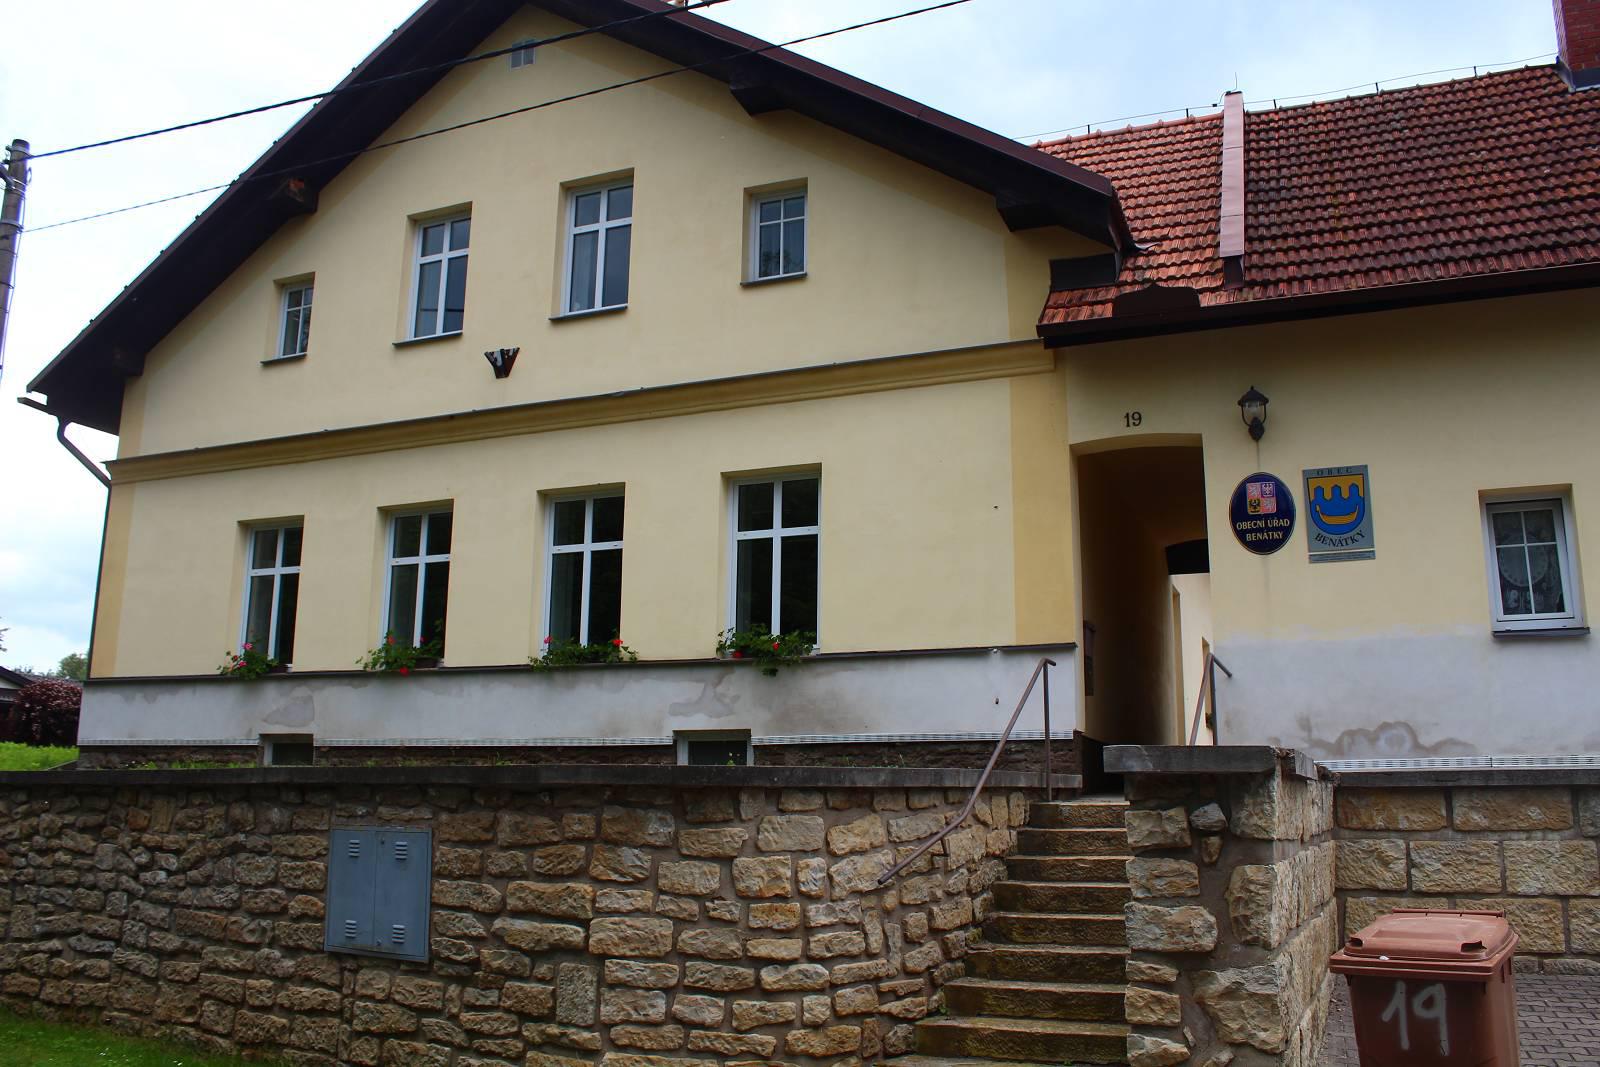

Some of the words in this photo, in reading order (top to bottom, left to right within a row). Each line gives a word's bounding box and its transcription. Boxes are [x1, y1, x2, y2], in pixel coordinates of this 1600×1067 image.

[1123, 411, 1142, 427] 19
[1316, 467, 1353, 476] OBEC
[1236, 518, 1266, 530] OBECNÍ
[1267, 517, 1290, 528] ÚŘAD
[1246, 530, 1284, 541] BENÁTKY
[1314, 529, 1366, 548] BENÁTKY
[1381, 980, 1450, 1057] 19
